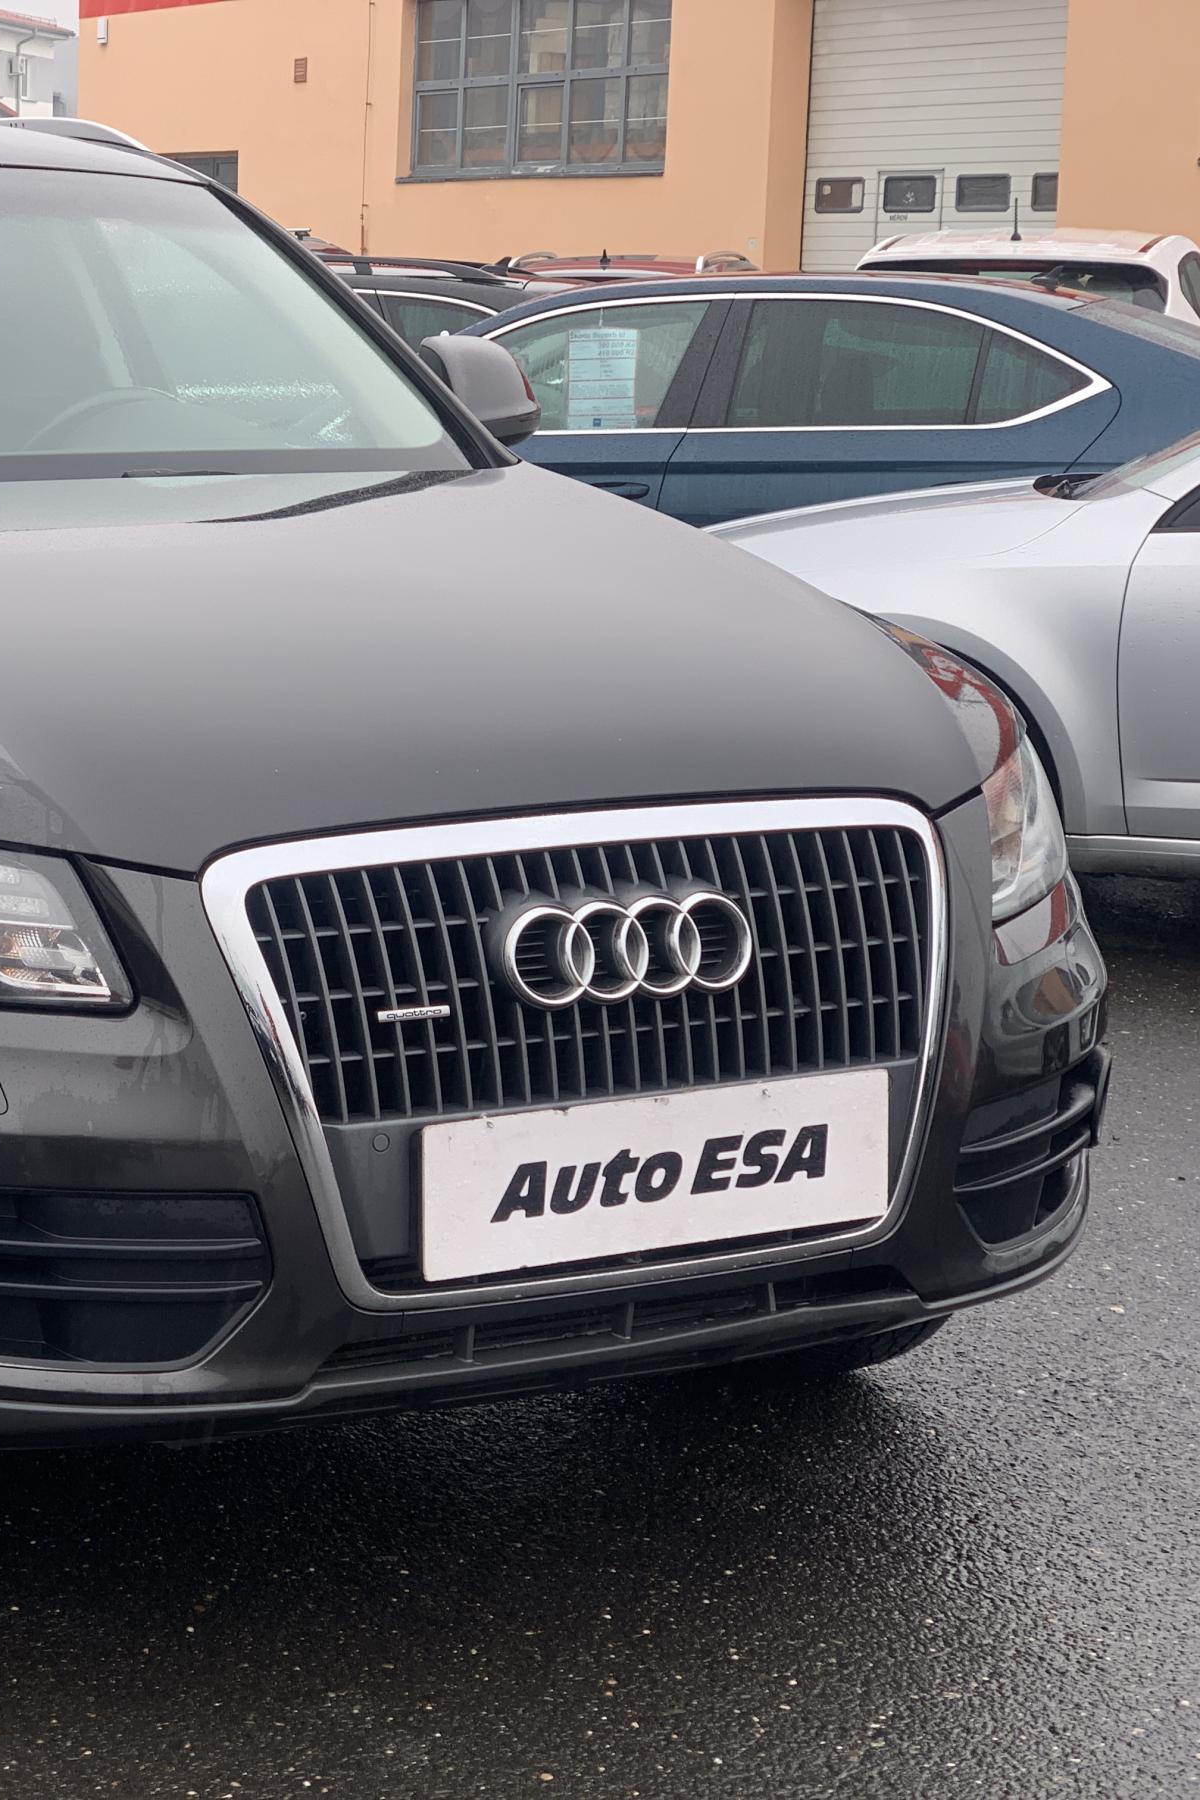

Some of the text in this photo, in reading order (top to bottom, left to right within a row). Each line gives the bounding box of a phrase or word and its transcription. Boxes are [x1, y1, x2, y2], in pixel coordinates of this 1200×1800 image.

[386, 1008, 442, 1020] quattro
[490, 1123, 829, 1223] Auto ESA
